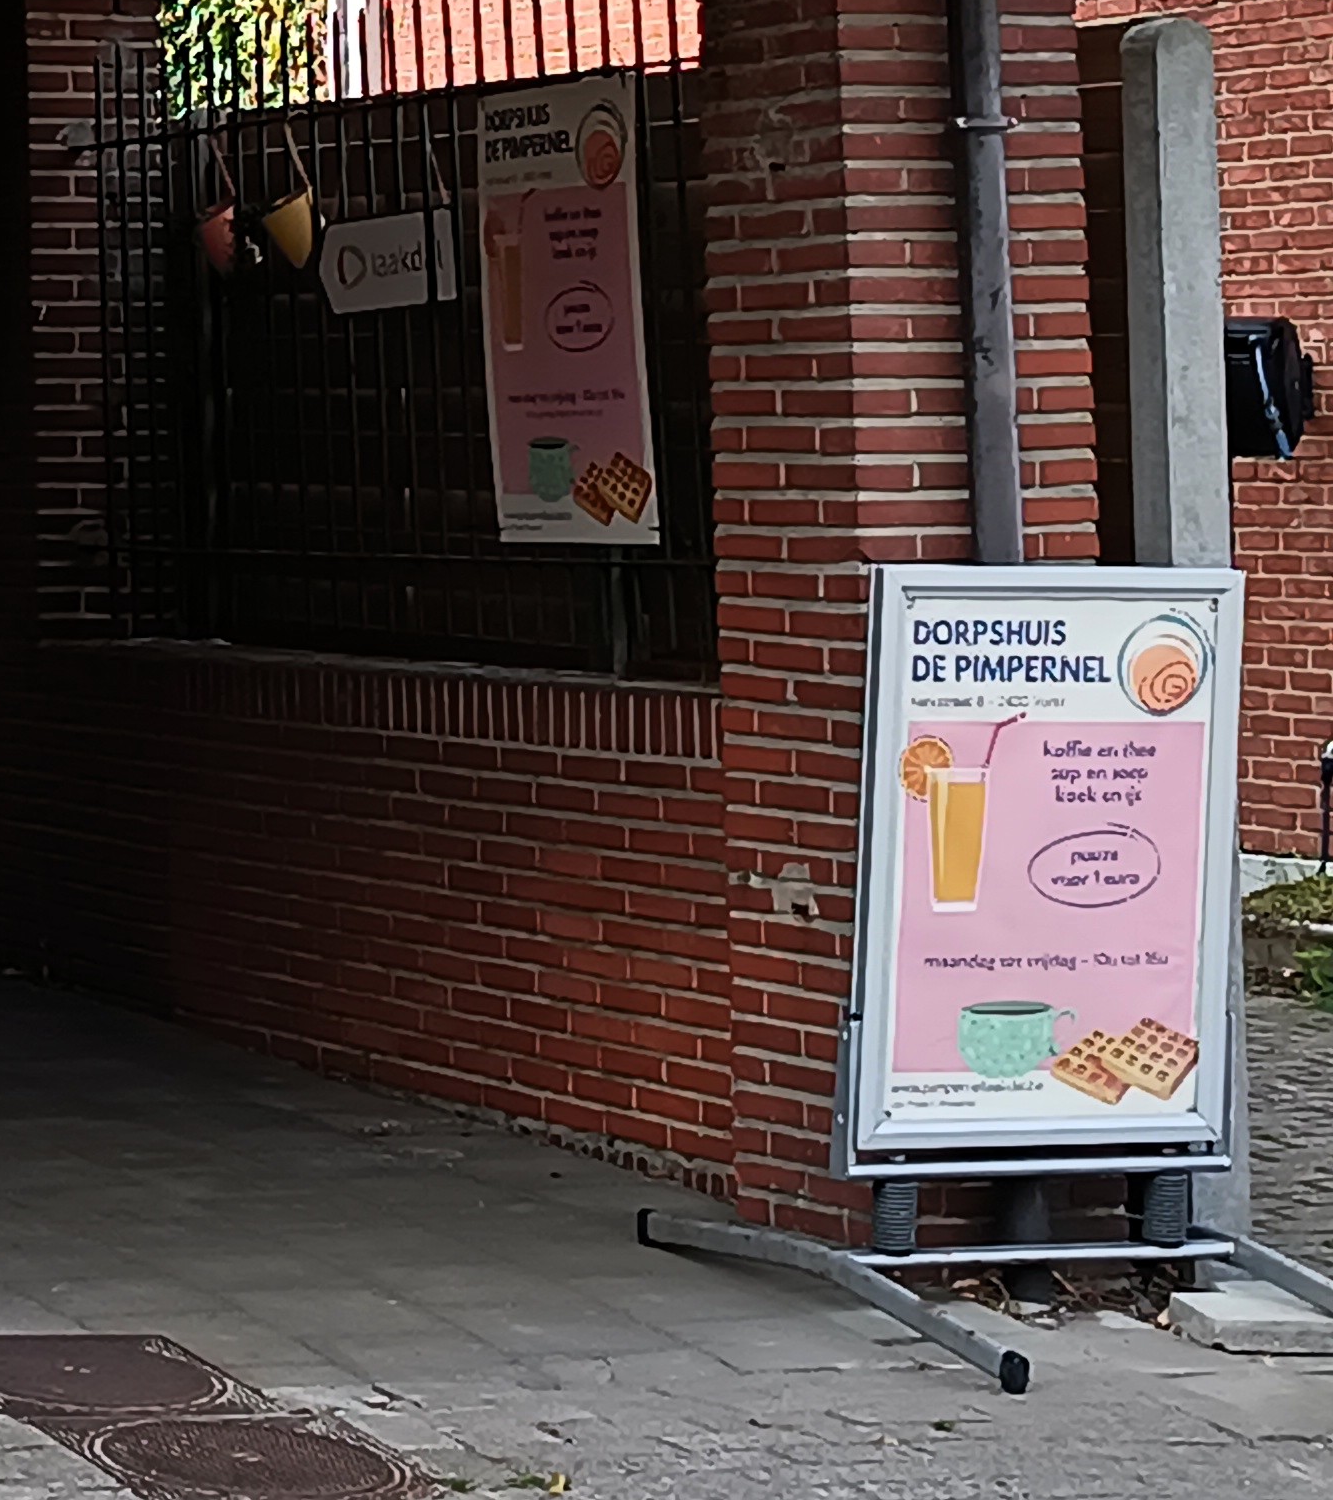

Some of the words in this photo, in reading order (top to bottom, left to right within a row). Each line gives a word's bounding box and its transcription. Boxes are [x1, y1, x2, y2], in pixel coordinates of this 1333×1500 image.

[912, 618, 1068, 647] DORPSHUIS
[911, 654, 945, 683] DE
[954, 653, 1112, 683] PIMPERNEL
[1043, 739, 1093, 757] koffie
[1097, 745, 1119, 757] en
[1122, 740, 1157, 758] thee
[1086, 768, 1108, 779] en
[1102, 791, 1122, 803] en
[1093, 869, 1101, 884] 1
[1103, 873, 1140, 885] euro
